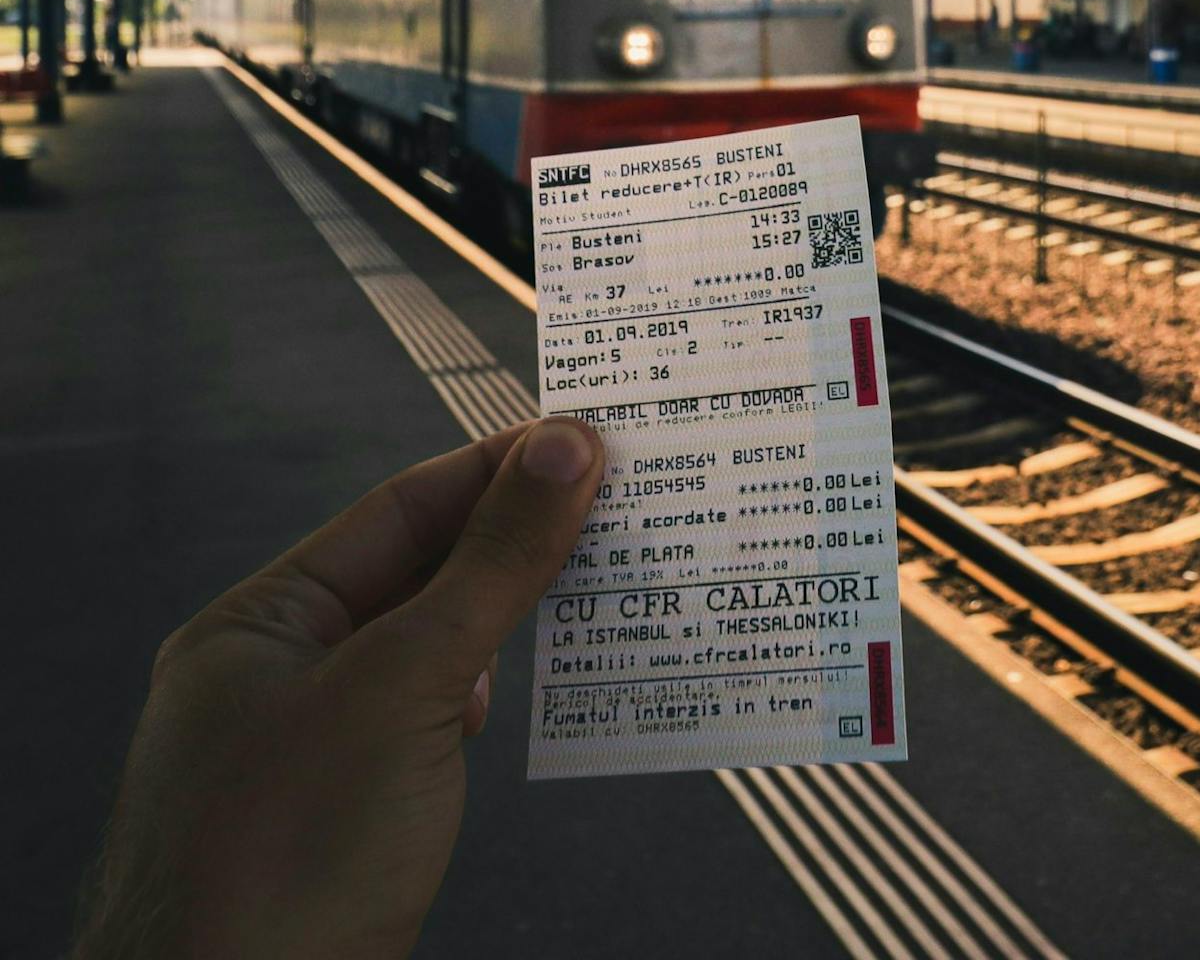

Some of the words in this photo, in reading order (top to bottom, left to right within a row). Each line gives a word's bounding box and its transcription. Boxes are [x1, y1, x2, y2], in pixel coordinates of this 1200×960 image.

[539, 165, 590, 183] SNTFC
[621, 155, 701, 177] DHRX8565
[717, 143, 783, 165] BUSTENI
[540, 189, 589, 206] Bilet
[777, 162, 795, 177] 01
[540, 216, 576, 225] Motiv
[582, 208, 632, 221] Student
[720, 181, 808, 206] C-0120089
[572, 229, 642, 250] Busteni
[751, 209, 800, 228] 14:33
[573, 255, 634, 270] Brasov
[752, 230, 801, 249] 15:27
[542, 285, 563, 293] Via
[585, 293, 599, 302] Km
[606, 285, 626, 299] 37
[648, 285, 668, 294] Lei
[585, 320, 688, 344] 01.09.2019
[763, 305, 823, 324] IR1937
[688, 341, 697, 354] 2
[546, 370, 637, 391] Loc(uri):
[650, 365, 669, 380] 36
[831, 386, 846, 397] EL
[575, 403, 647, 423] VALABIL
[659, 398, 699, 416] DOAR
[711, 395, 730, 411] CU
[742, 387, 804, 408] DOVADA
[593, 422, 626, 433] tului
[657, 415, 714, 426] reducere
[723, 407, 773, 419] conform
[634, 452, 716, 474] DHRX8564
[733, 444, 806, 465] BUSTENI
[623, 476, 706, 498] 11054545
[851, 470, 881, 488] Lei
[580, 515, 629, 534] uceri
[642, 508, 727, 529] acordate
[852, 493, 883, 511] Lei
[562, 553, 598, 570] TAL
[610, 549, 629, 566] DE
[641, 544, 694, 563] PLATA
[853, 528, 884, 546] Lei
[575, 577, 604, 587] care
[612, 572, 634, 583] TVA
[642, 570, 663, 581] 19%
[679, 567, 700, 578] Lei
[555, 597, 597, 623] CU
[620, 591, 682, 618] CFR
[706, 576, 880, 612] CALATORI
[553, 631, 574, 647] LA
[586, 624, 670, 645] ISTANBUL
[683, 622, 701, 638] si
[716, 610, 859, 635] THESSALONIKI!
[552, 653, 635, 674] Detalii:
[650, 640, 851, 668] www.cfrcalatori.ro
[724, 676, 768, 689] timpul
[543, 706, 617, 726] Fumatul
[635, 700, 720, 721] interzis
[736, 697, 754, 714] in
[769, 696, 812, 712] tren
[607, 696, 620, 706] de
[542, 727, 594, 739] Valabil
[637, 721, 699, 735] DHRX8565
[843, 721, 858, 733] EL
